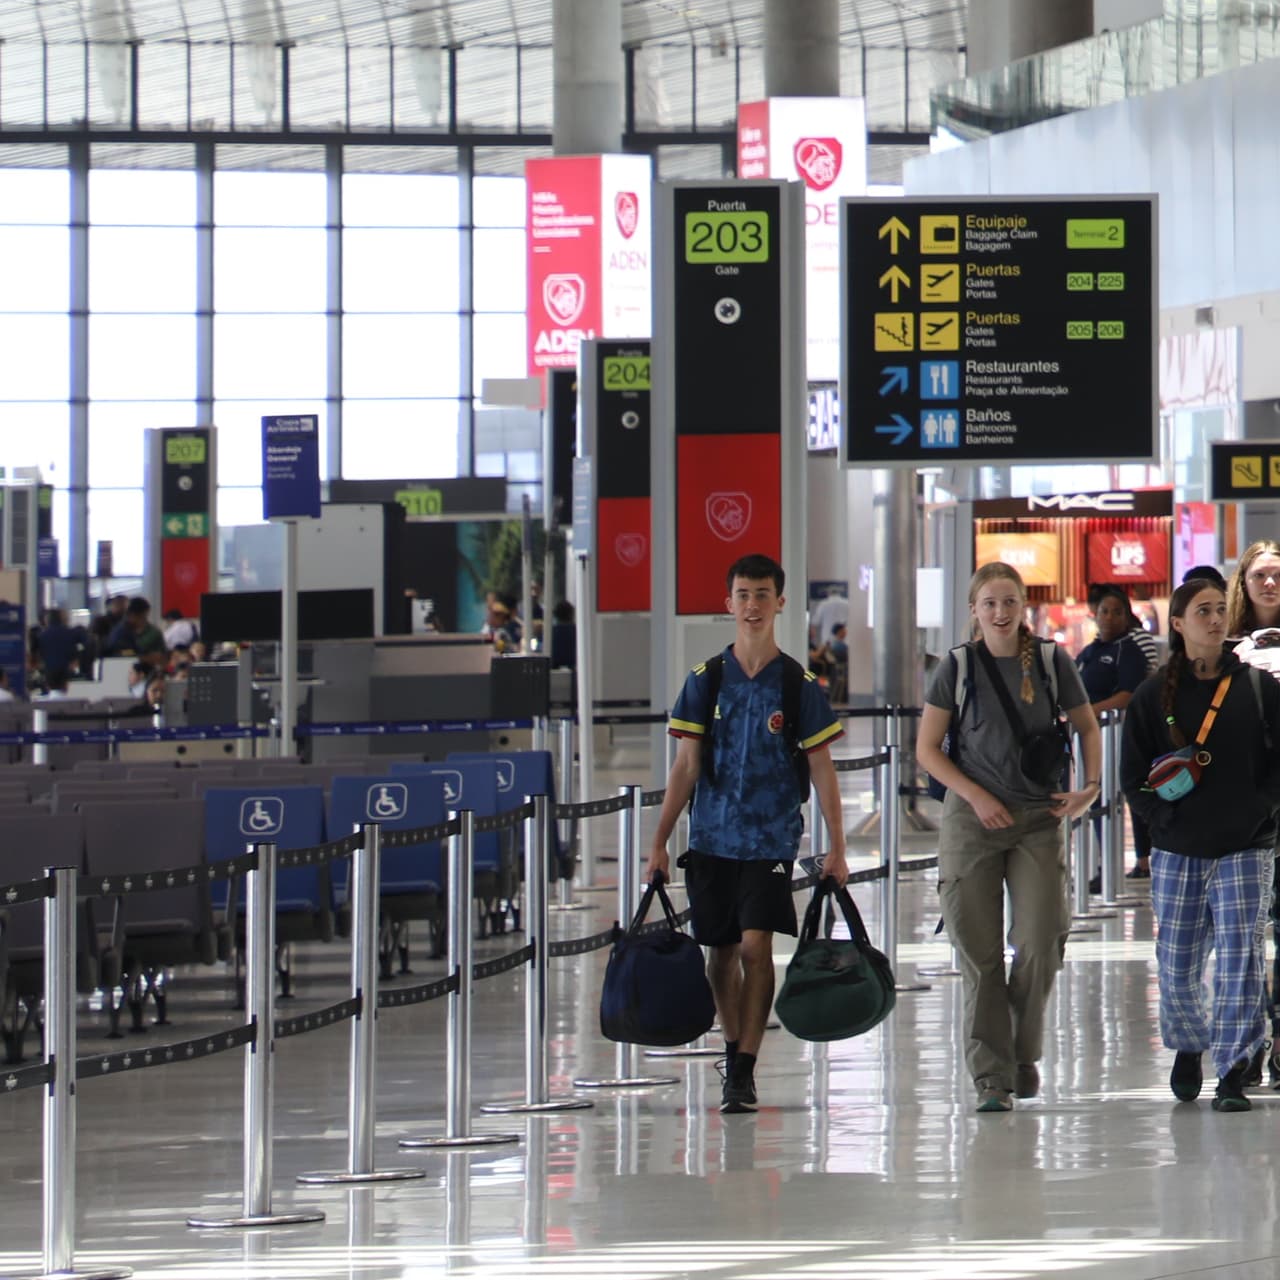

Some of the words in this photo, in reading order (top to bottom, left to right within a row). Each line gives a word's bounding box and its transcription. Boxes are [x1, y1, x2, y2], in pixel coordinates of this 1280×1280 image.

[707, 200, 746, 211] Puerta
[966, 215, 1027, 230] Equipaje
[691, 221, 763, 253] 203
[965, 230, 1008, 240] Baggage
[1010, 229, 1037, 239] Claim
[1108, 226, 1118, 241] 2
[965, 241, 1011, 252] Bagagem
[715, 266, 739, 275] Gate
[966, 264, 1021, 277] Puertas
[965, 279, 994, 288] Gates
[1068, 277, 1091, 287] 204
[1099, 277, 1122, 287] 225
[965, 290, 997, 299] Portas
[966, 312, 1021, 325] Puertas
[965, 327, 994, 336] Gates
[1068, 325, 1091, 336] 205
[1099, 325, 1122, 336] 206
[965, 338, 997, 347] Portas
[966, 361, 1060, 373] Restaurantes
[606, 363, 650, 383] 204
[965, 375, 1022, 384] Restaurants
[995, 386, 1008, 395] de
[966, 409, 1011, 421] Baños
[965, 424, 1017, 433] Bathrooms
[965, 435, 1014, 444] Banheiros
